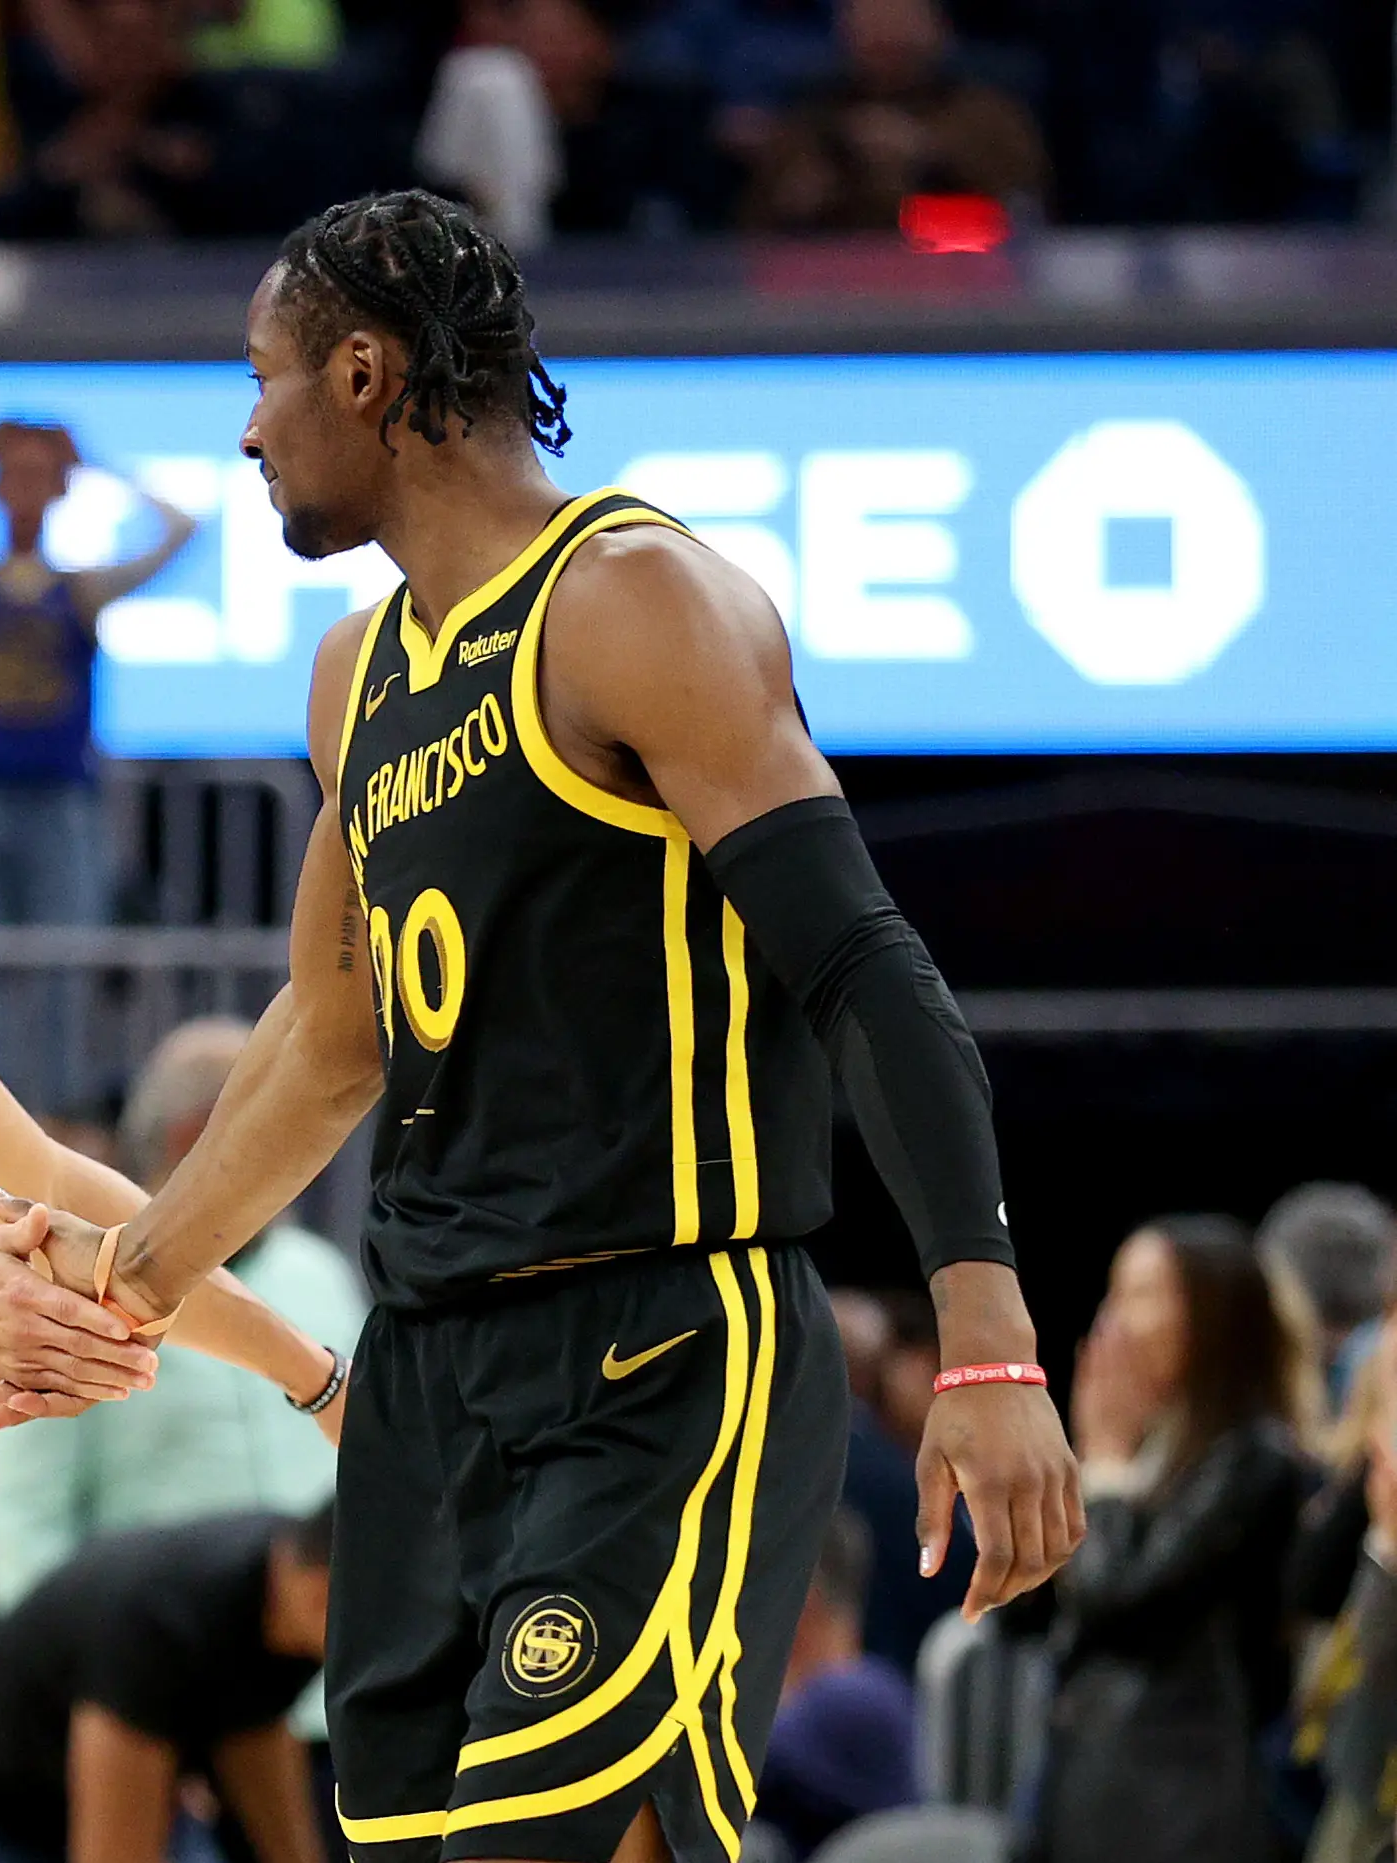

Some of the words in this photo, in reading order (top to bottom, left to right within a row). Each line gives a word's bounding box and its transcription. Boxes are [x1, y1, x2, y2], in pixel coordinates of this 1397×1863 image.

[43, 448, 974, 664] CHSE
[458, 628, 518, 667] Rakuten
[366, 692, 509, 843] FRANCISCO
[964, 1368, 1006, 1381] Bryant
